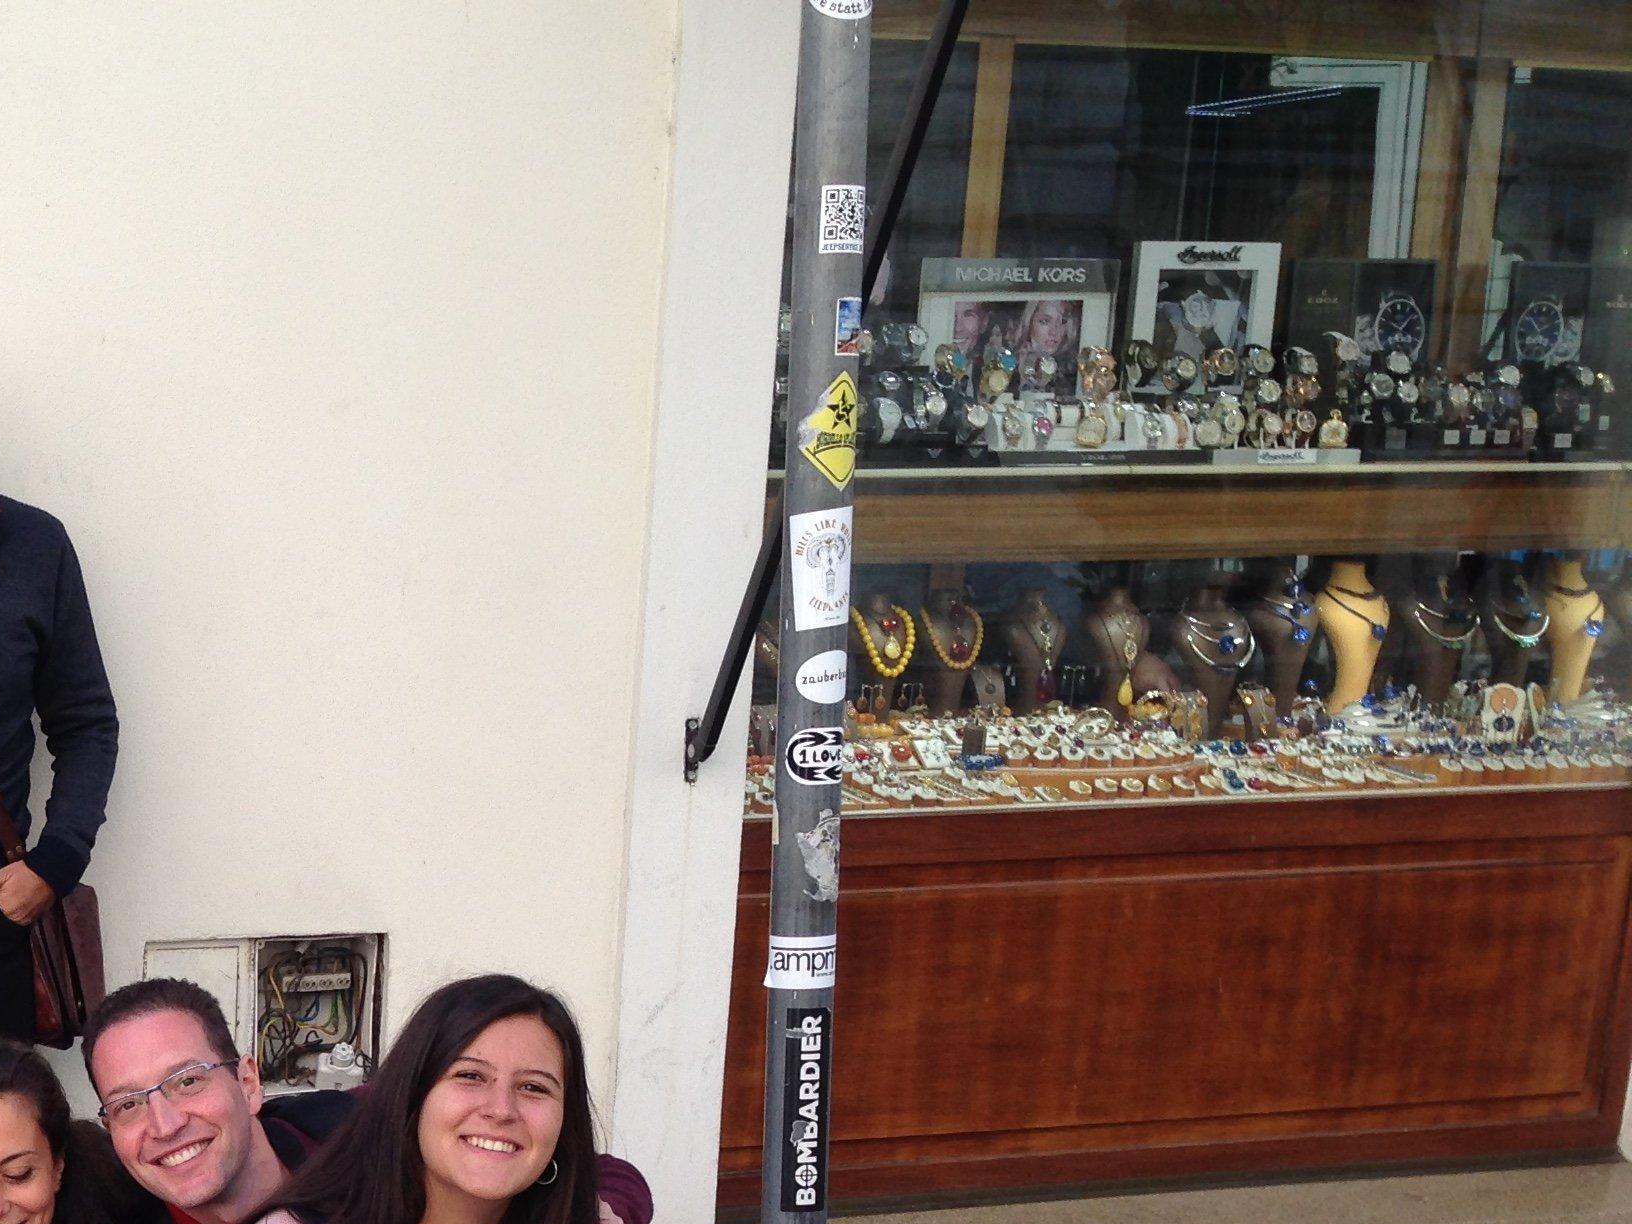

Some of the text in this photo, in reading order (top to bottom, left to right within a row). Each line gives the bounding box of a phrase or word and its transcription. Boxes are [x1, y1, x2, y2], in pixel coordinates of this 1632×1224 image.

[955, 267, 1087, 283] MICHAEL KORS
[814, 519, 837, 532] LIKE
[799, 749, 842, 765] 1 LOVE
[795, 1014, 823, 1206] BOMBARDIER
